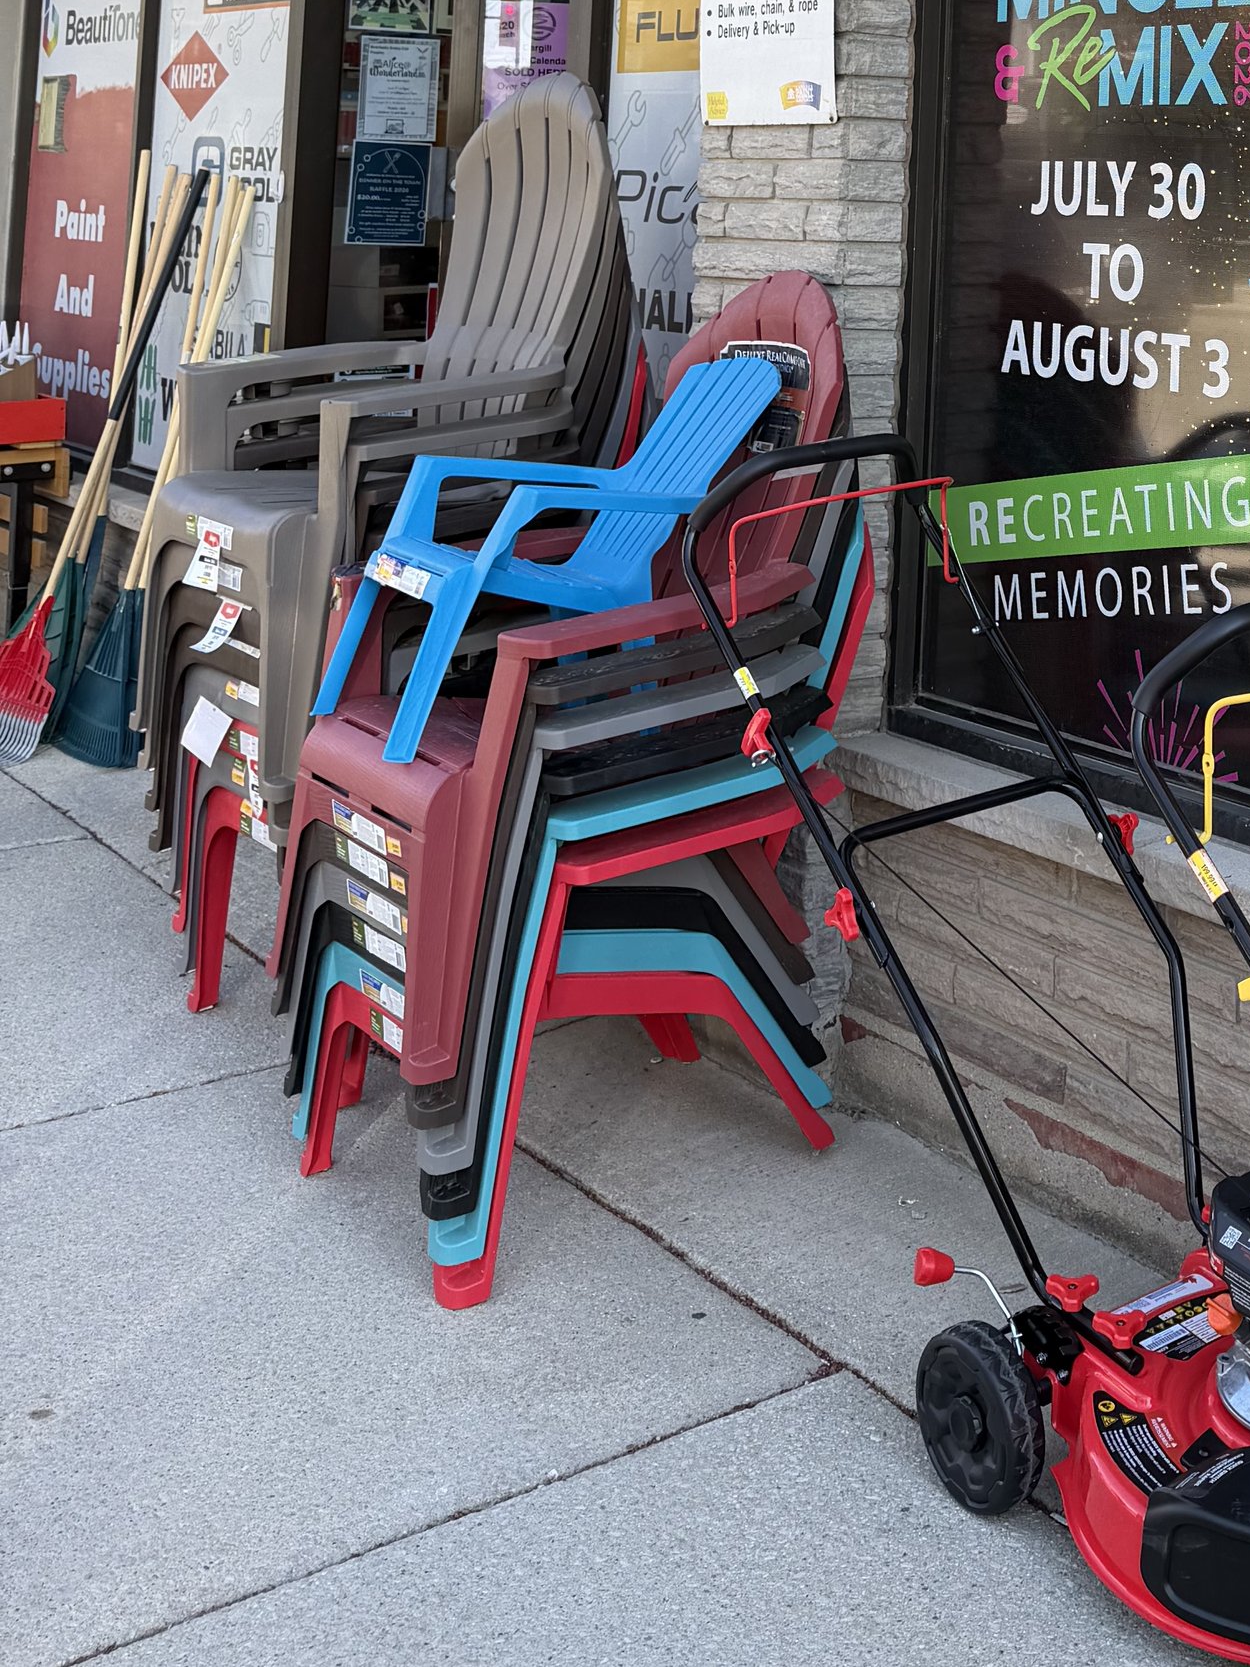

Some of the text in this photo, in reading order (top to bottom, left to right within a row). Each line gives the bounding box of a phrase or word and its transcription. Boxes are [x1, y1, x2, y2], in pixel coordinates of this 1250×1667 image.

[636, 5, 700, 43] FLU
[718, 3, 735, 18] Bulk
[718, 20, 796, 39] Delivery & Pick-up
[171, 62, 217, 90] KNIPEX
[994, 44, 1025, 103] &
[230, 146, 279, 171] GRAY
[1031, 160, 1206, 221] JULY 30
[55, 199, 106, 242] Paint
[1082, 243, 1144, 302] TO
[54, 274, 95, 317] And
[1001, 320, 1231, 399] AUGUST 3
[969, 475, 1250, 547] RECREATING
[994, 561, 1234, 622] MEMORIES
